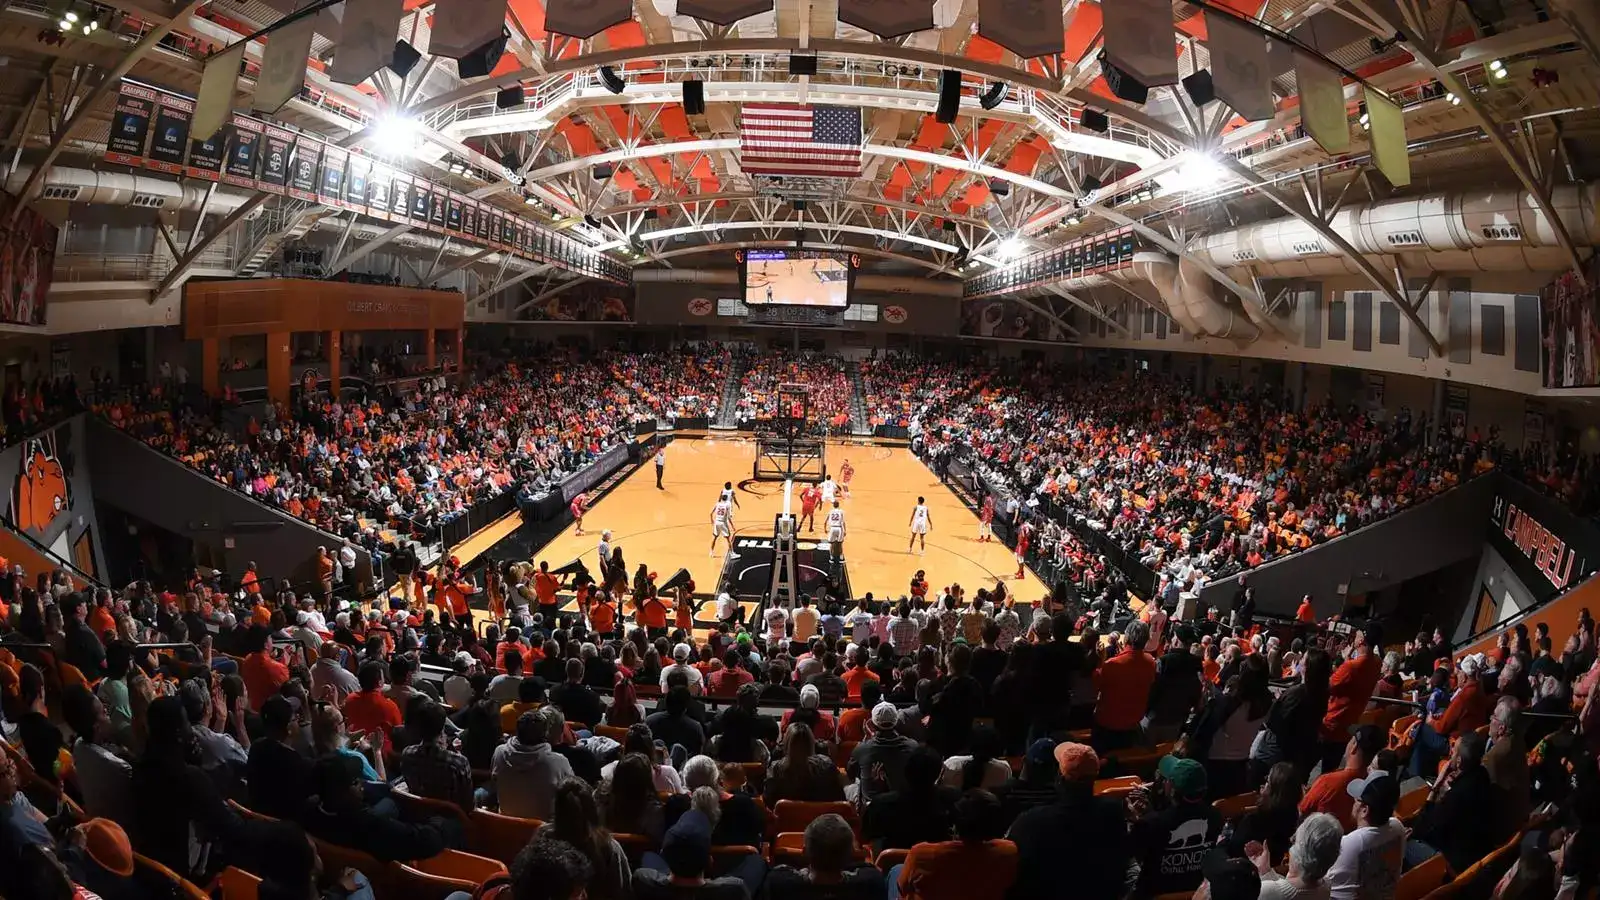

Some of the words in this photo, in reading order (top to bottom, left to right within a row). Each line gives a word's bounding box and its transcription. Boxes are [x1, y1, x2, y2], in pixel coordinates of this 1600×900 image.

[120, 86, 155, 99] CAMPBELL
[162, 95, 193, 112] CAMPBELL
[233, 117, 262, 131] CAMPBELL
[266, 128, 293, 141] CAMPBELL
[1504, 503, 1576, 590] CAMPBELL
